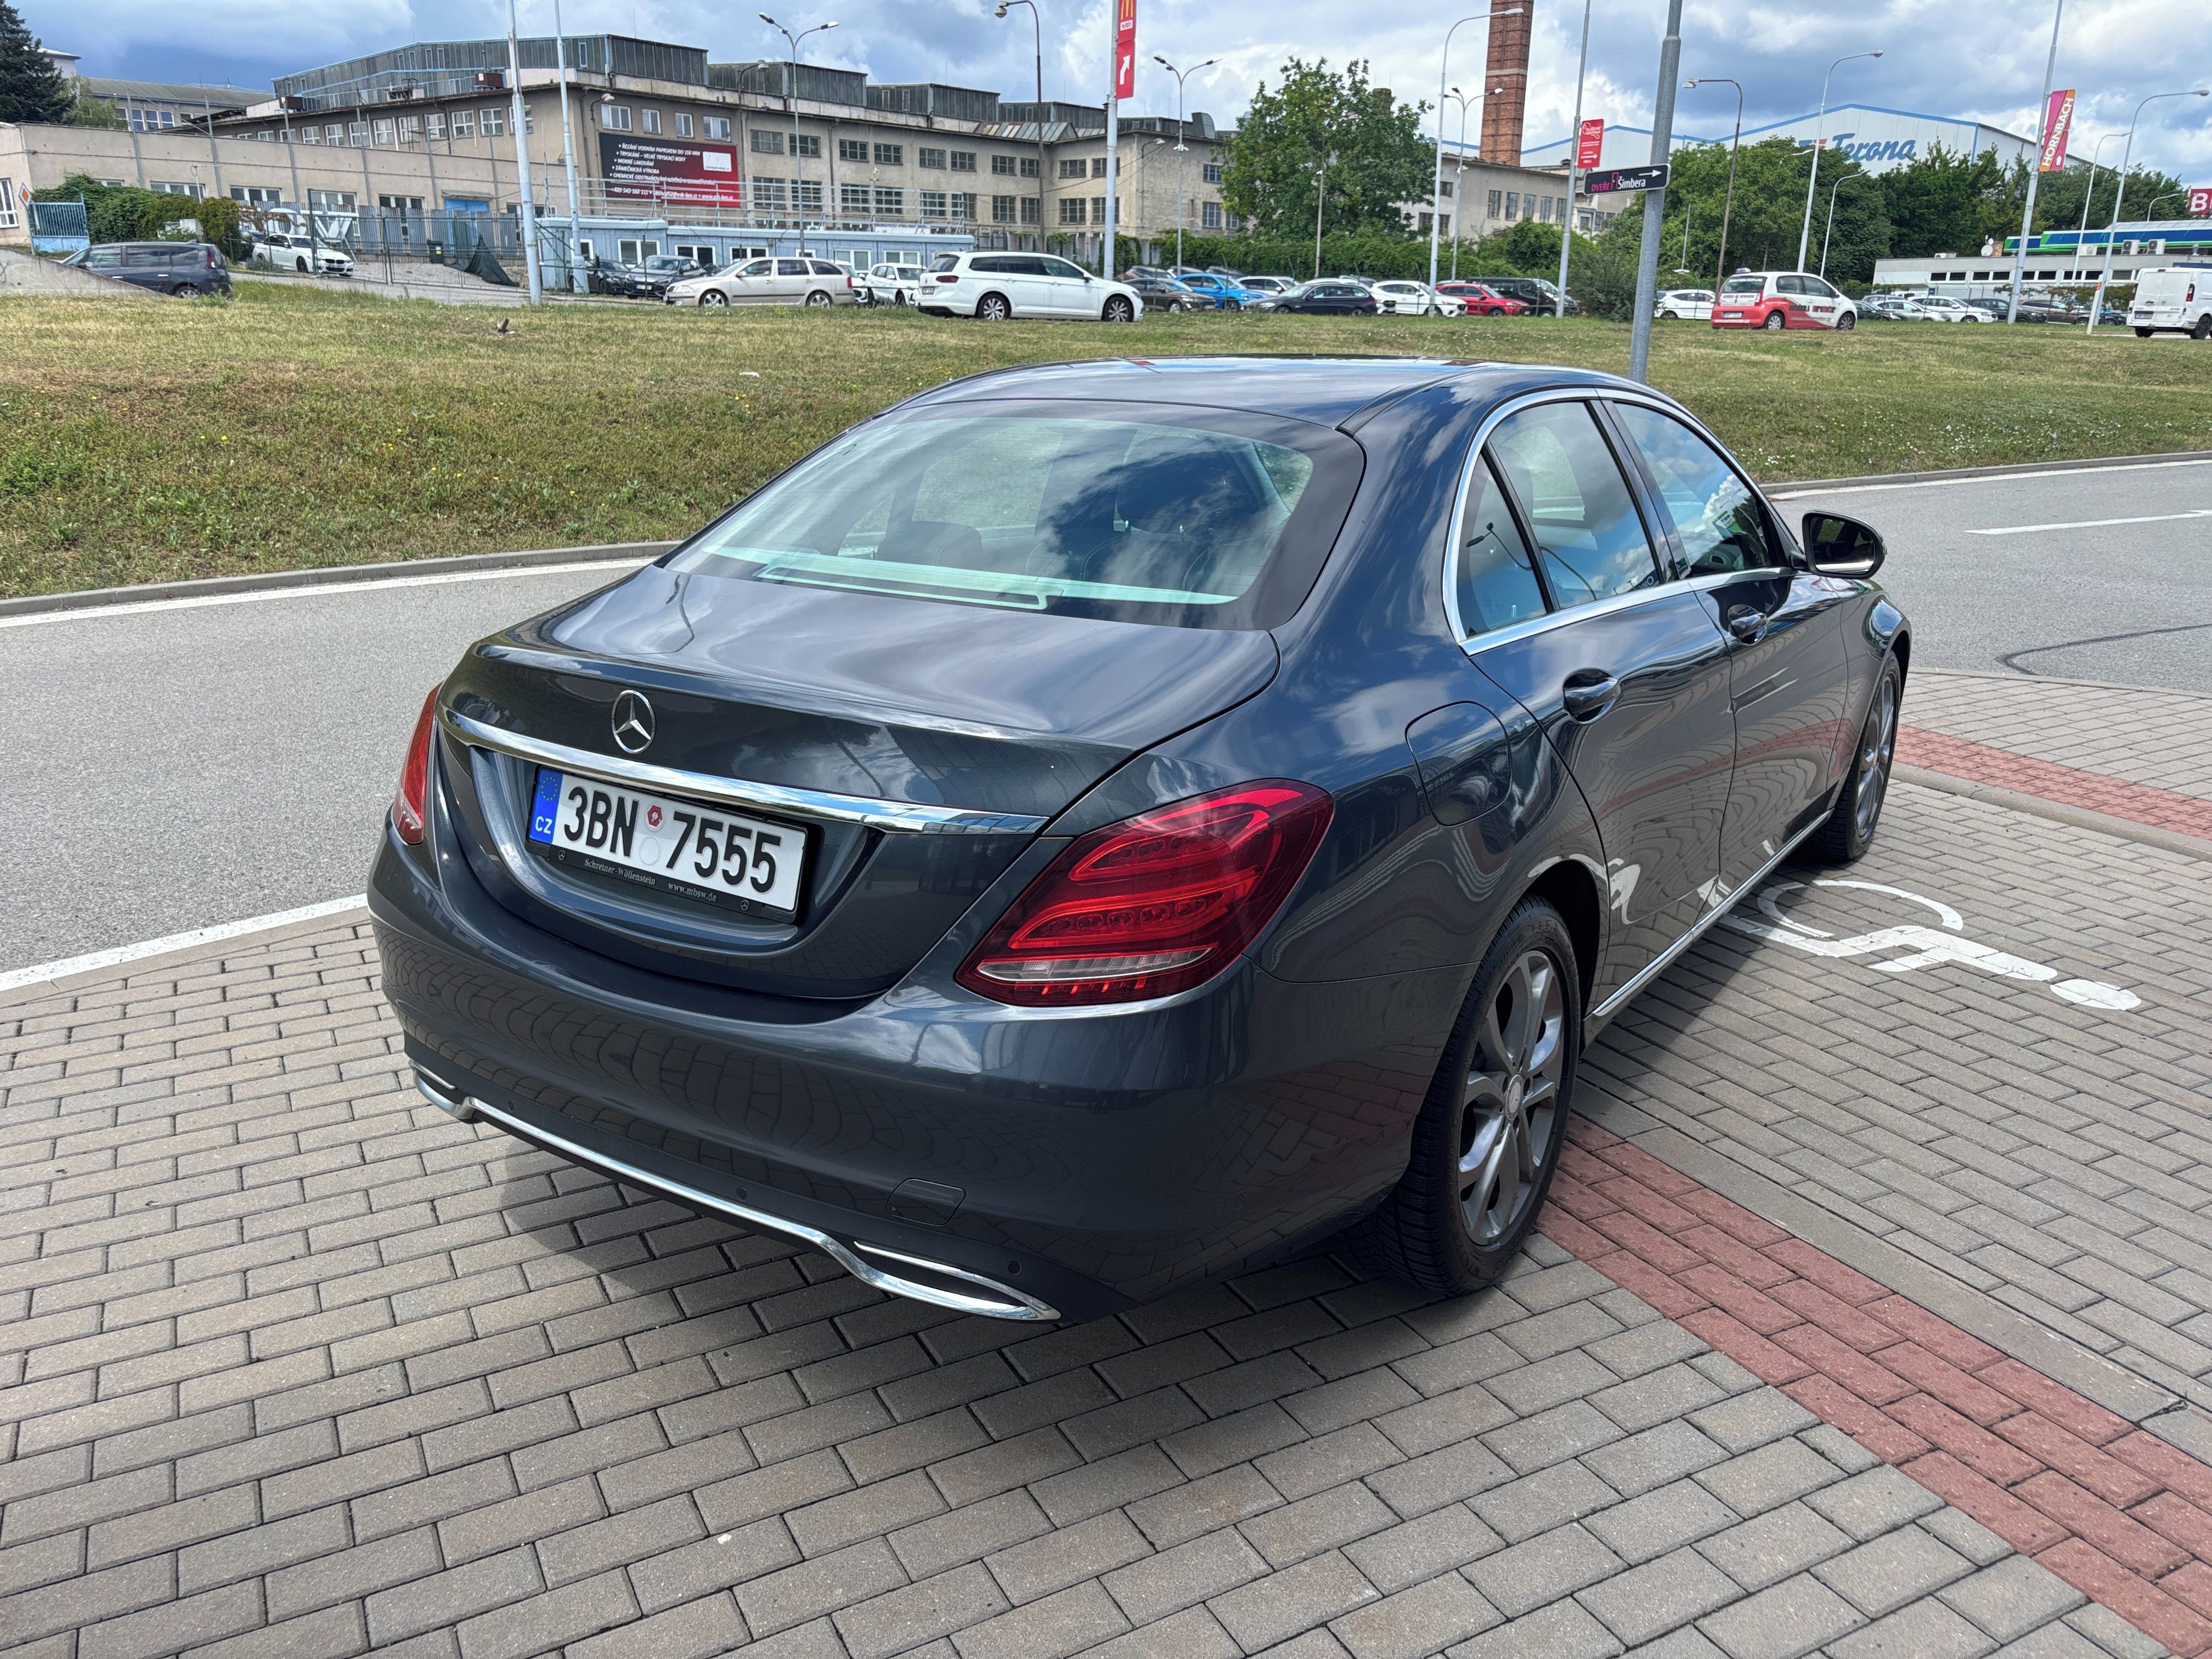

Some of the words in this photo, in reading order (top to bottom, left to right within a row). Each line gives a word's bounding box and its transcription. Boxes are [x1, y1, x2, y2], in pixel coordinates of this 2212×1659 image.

[2041, 98, 2074, 167] HORNBACH
[1591, 181, 1610, 191] DVEŘE
[1617, 176, 1646, 189] Šimbera
[2190, 193, 2212, 212] B
[535, 816, 552, 834] CZ
[564, 787, 640, 857] 3BN
[666, 811, 782, 893] 7555
[668, 882, 717, 902] www.mbsw.de
